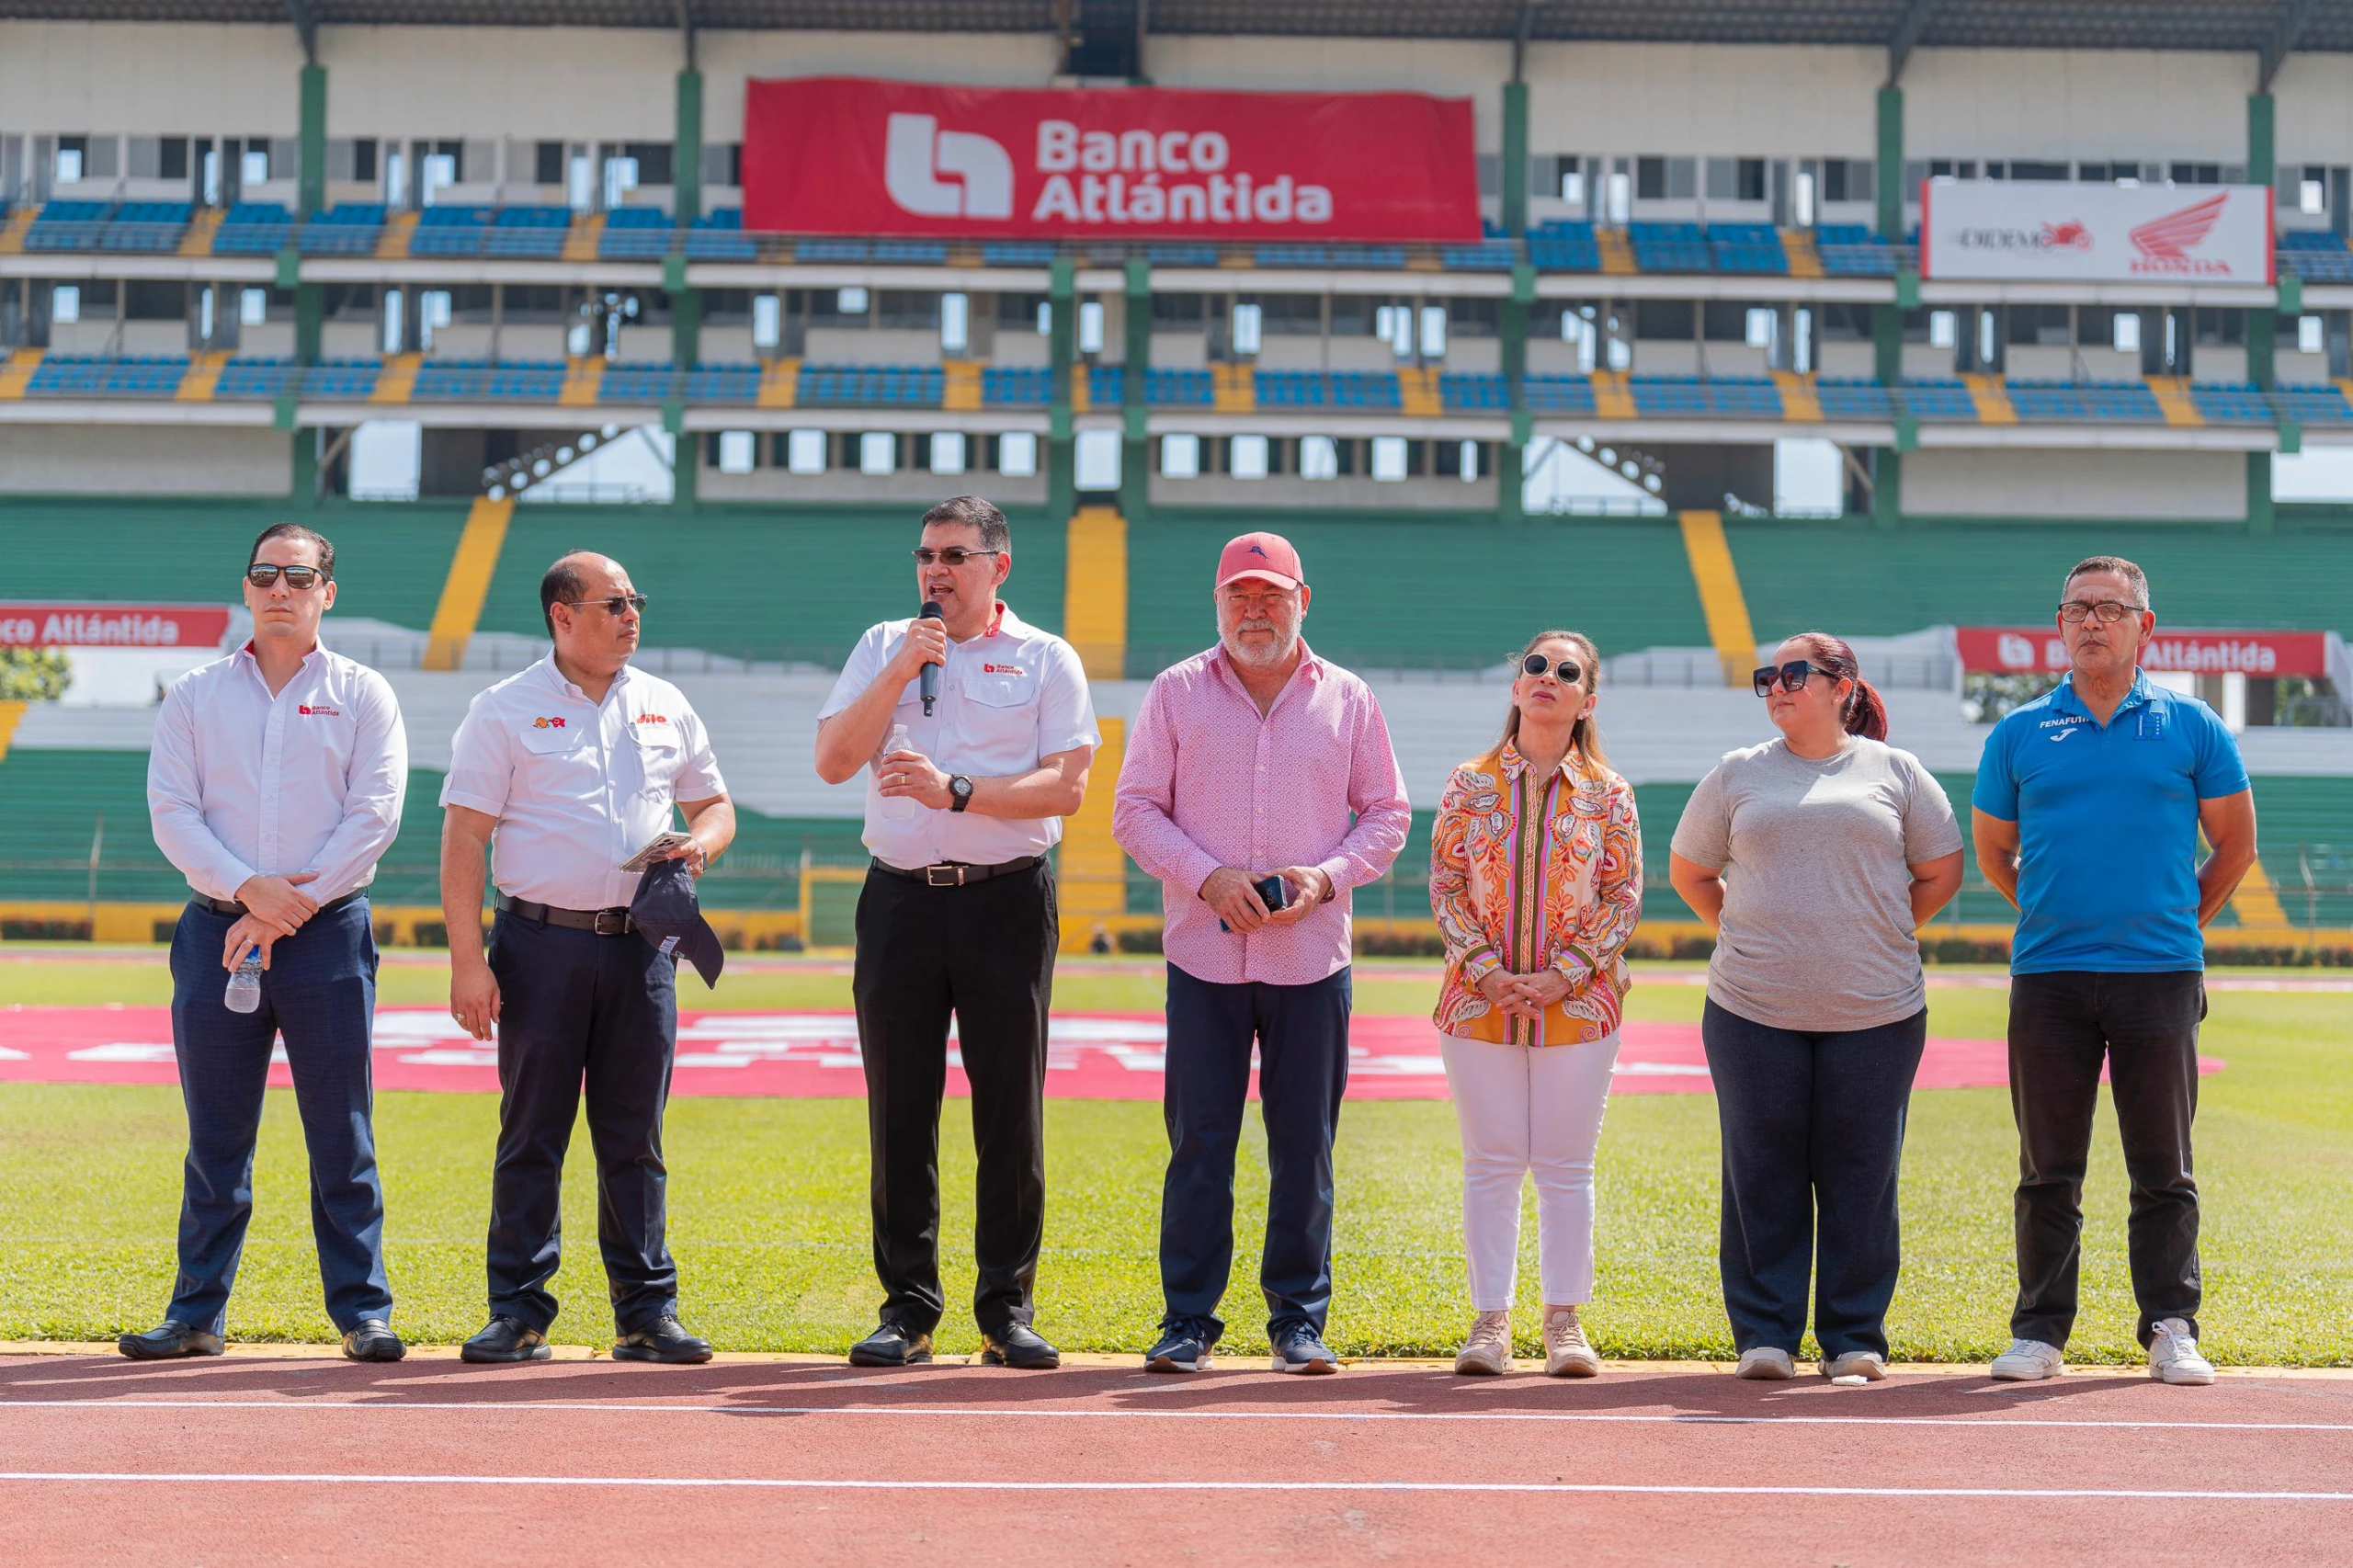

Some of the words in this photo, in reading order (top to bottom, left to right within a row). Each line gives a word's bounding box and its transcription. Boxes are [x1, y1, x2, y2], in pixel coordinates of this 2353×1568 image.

[1036, 119, 1230, 173] Banco
[1031, 172, 1334, 222] Atlántida
[2130, 257, 2234, 277] HONDA
[40, 612, 179, 645] Atlántida
[2141, 641, 2277, 672] Atlántida
